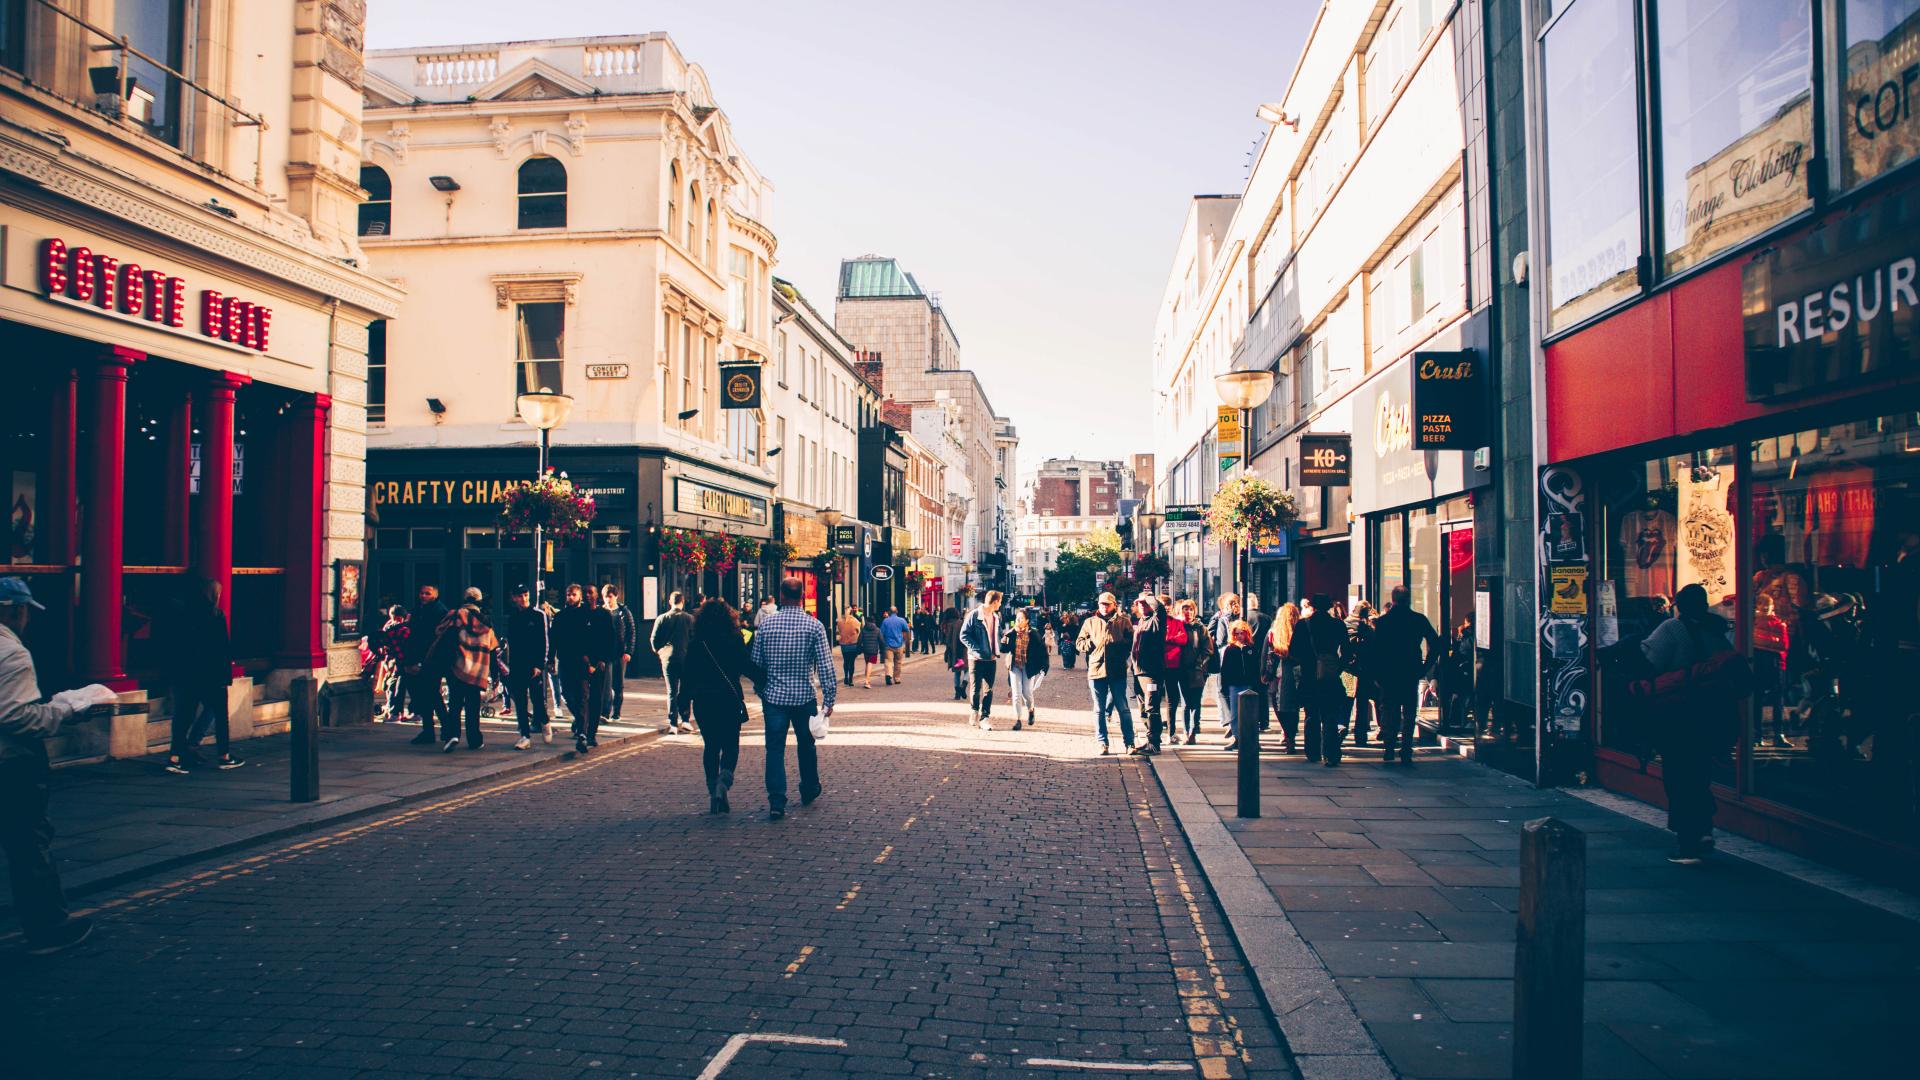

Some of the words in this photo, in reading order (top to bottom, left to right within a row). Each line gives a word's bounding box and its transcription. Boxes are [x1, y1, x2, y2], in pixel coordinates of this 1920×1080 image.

[1669, 185, 1725, 235] Vintage
[1728, 141, 1806, 200] Clothing
[1560, 239, 1627, 300] BARBERS
[40, 238, 185, 327] COYOTE
[201, 290, 273, 352] UGLY
[1776, 256, 1920, 348] RESUR
[1420, 359, 1473, 380] Crust
[1422, 415, 1451, 423] PIZZA
[1422, 424, 1452, 433] PASTA
[1422, 434, 1446, 442] BEER
[1314, 449, 1335, 467] KO
[375, 480, 456, 505] CRAFTY
